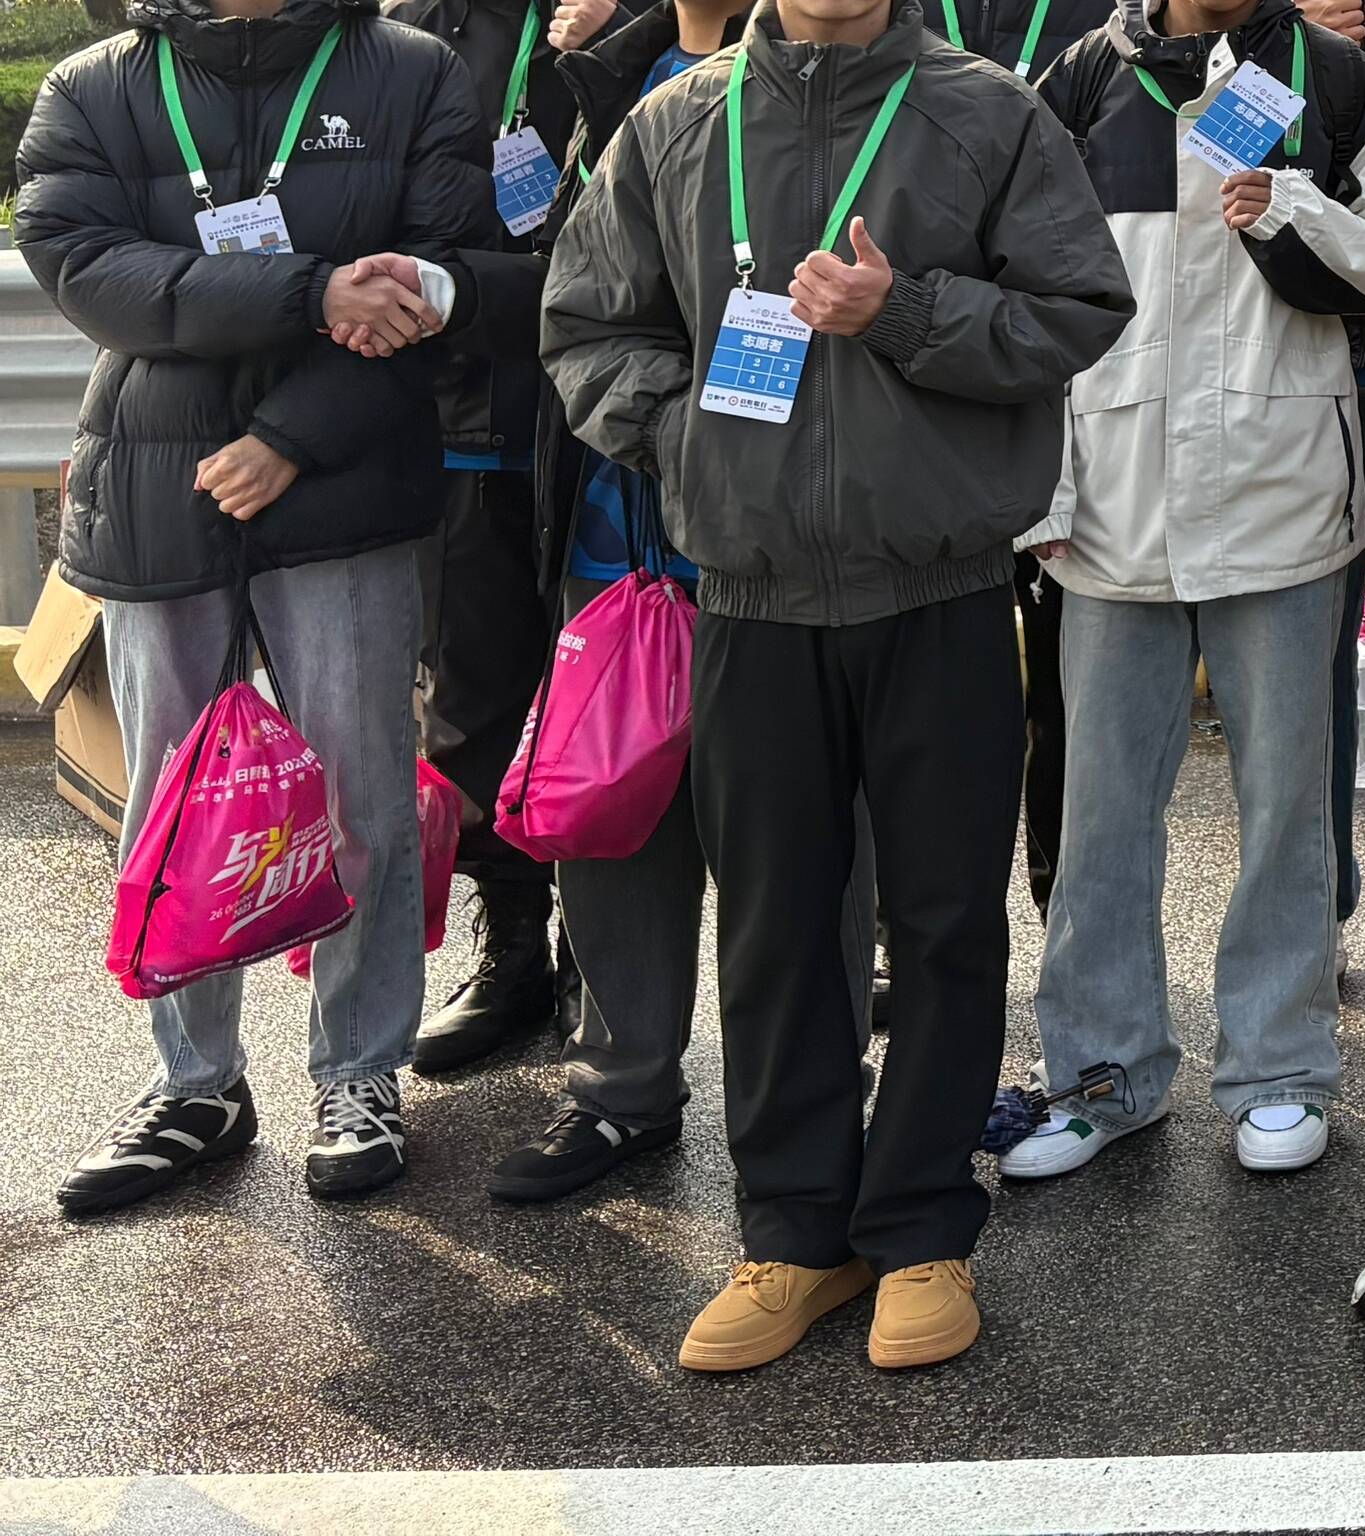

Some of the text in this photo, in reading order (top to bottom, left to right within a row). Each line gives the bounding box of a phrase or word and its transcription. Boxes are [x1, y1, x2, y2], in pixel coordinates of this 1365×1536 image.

[301, 137, 365, 151] CAMEL
[741, 334, 784, 353] 志愿者
